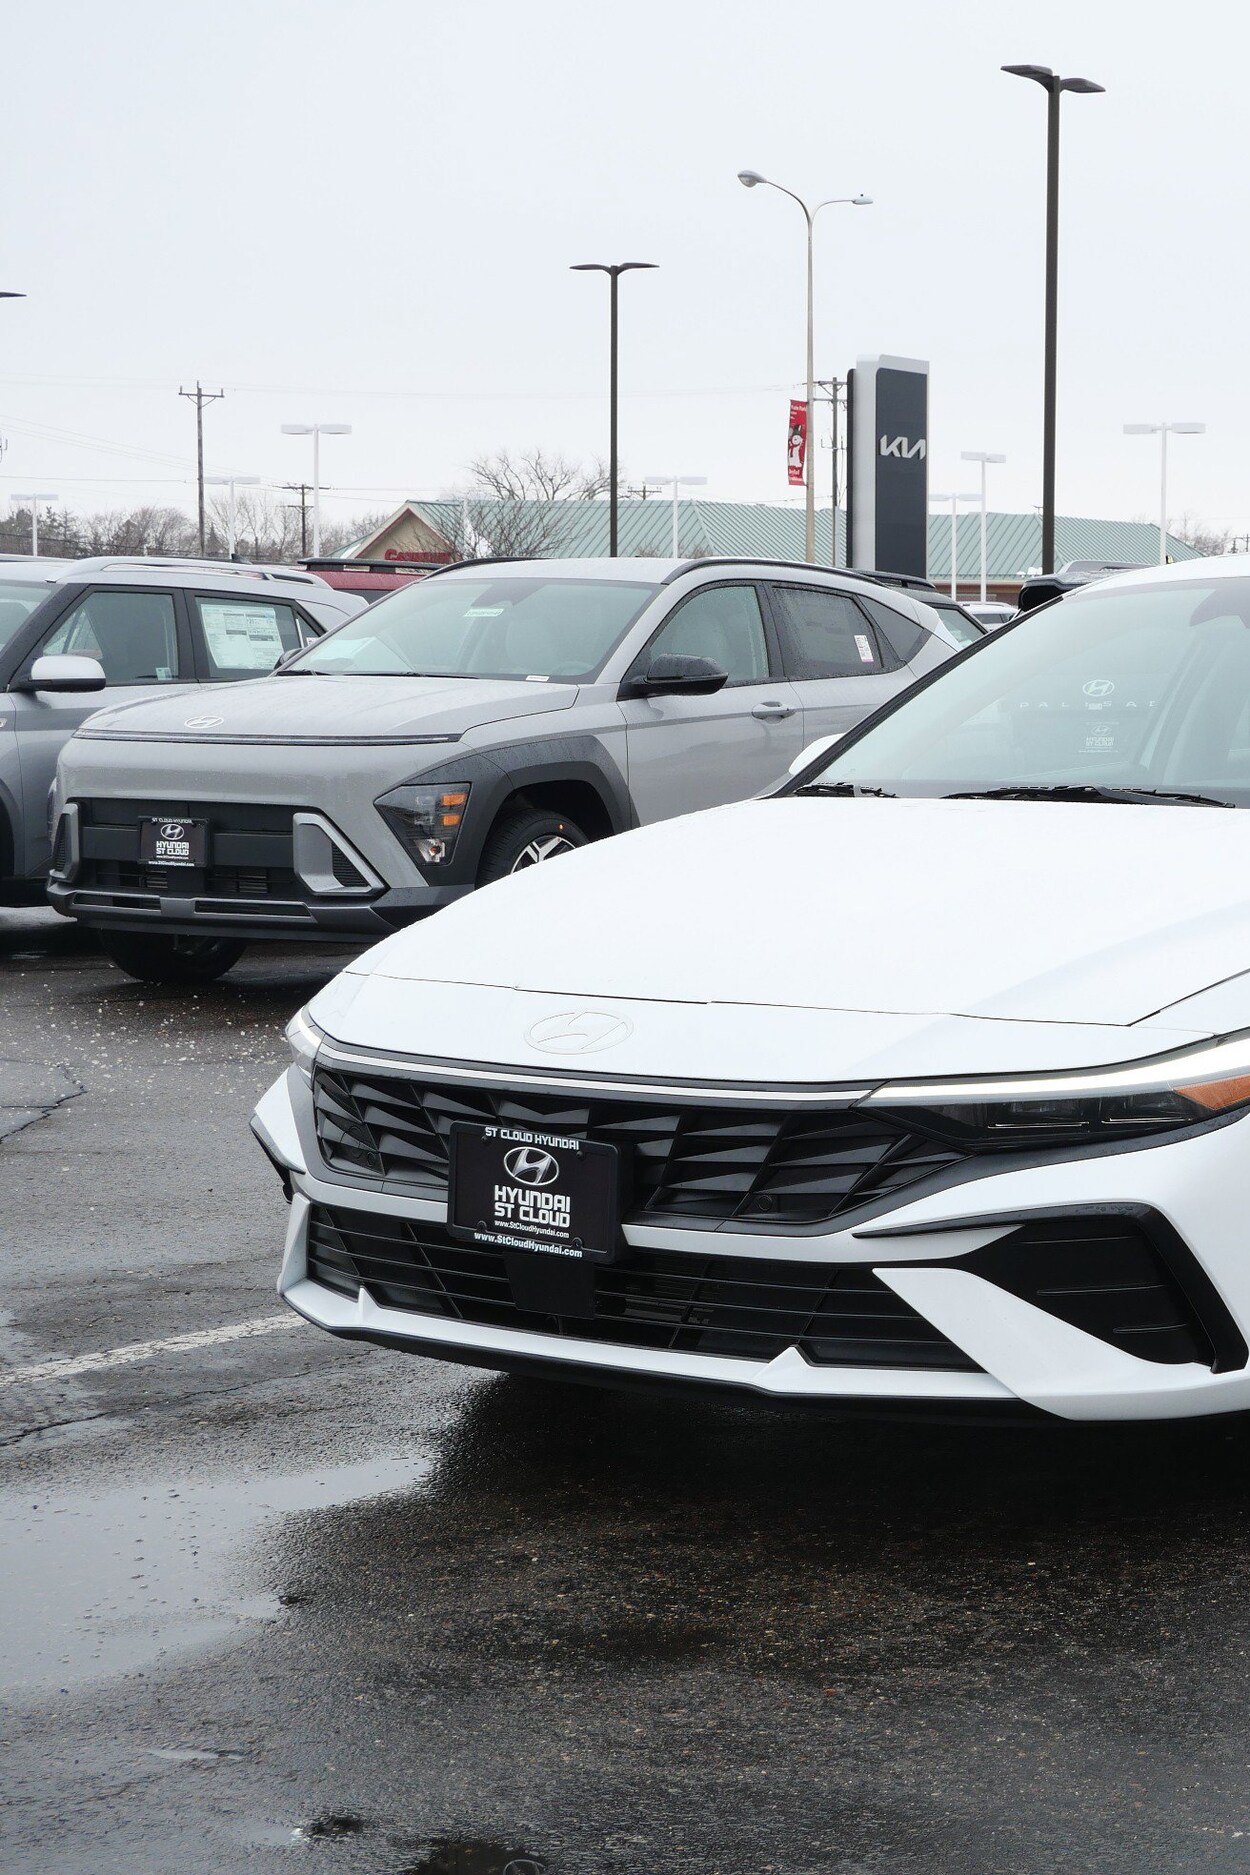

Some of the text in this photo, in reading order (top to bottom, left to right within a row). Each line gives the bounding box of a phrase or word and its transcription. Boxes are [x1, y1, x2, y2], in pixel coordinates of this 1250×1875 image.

[879, 434, 926, 460] KIA
[156, 841, 189, 849] HYUNDAI
[485, 1126, 580, 1151] ST CLOUD HYUNDAI
[493, 1184, 571, 1213] HYUNDAI
[493, 1202, 571, 1229] ST CLOUD
[494, 1219, 570, 1239] www.StCloudHyundai.com
[474, 1231, 583, 1258] www.StCloudHyundai.com
